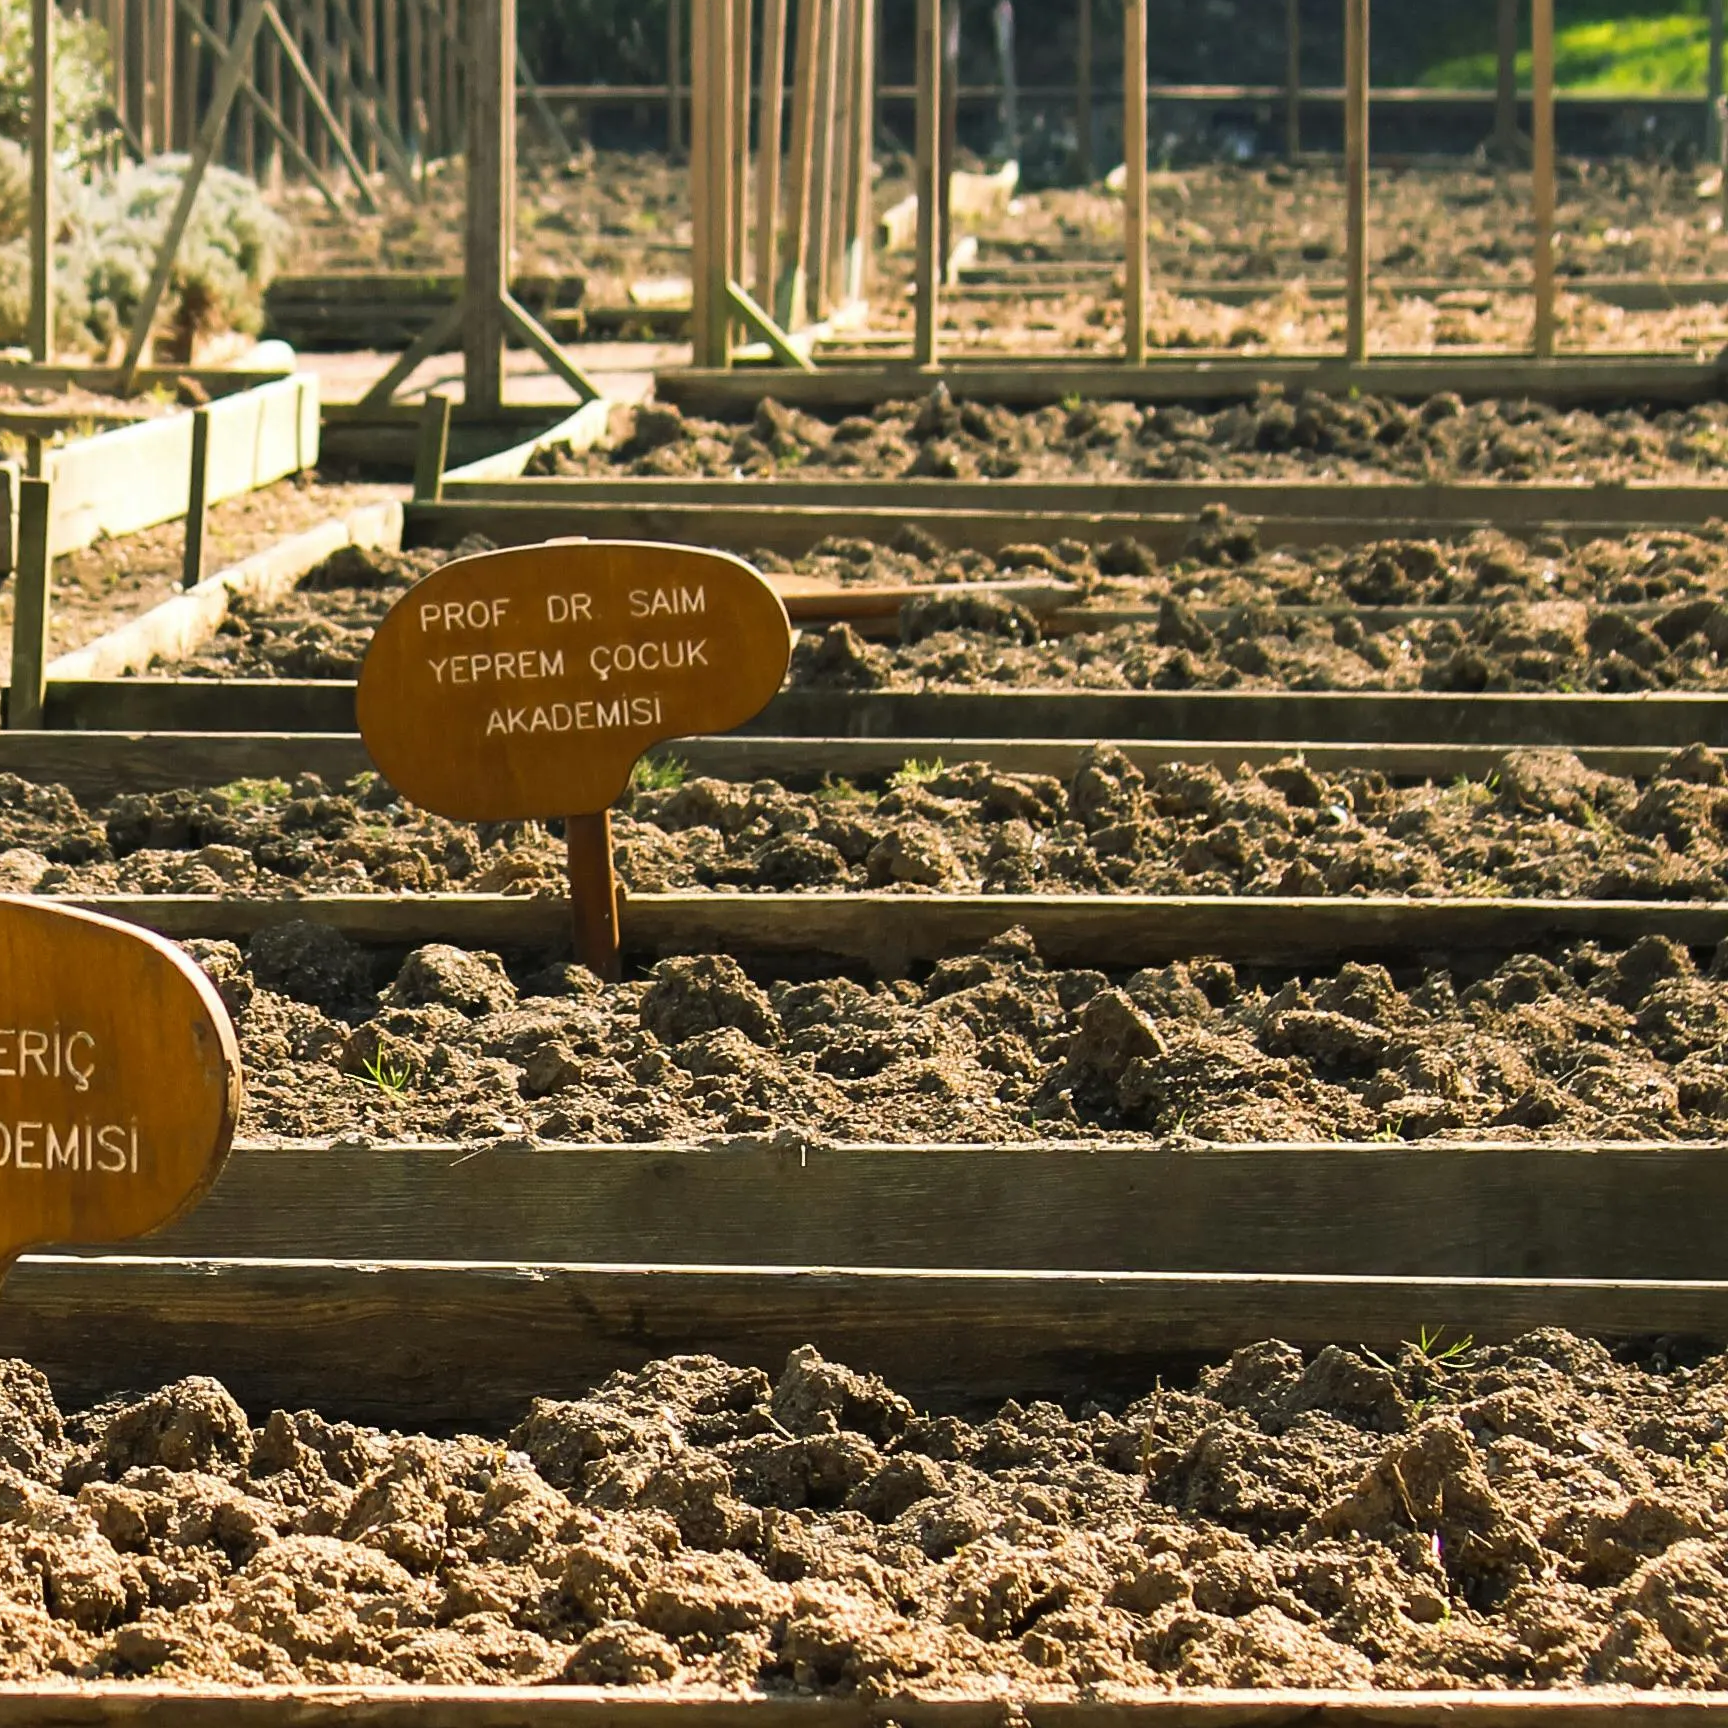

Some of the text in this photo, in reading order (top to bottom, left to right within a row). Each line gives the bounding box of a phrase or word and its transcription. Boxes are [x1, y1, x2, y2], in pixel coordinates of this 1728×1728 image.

[428, 638, 709, 684] YEPREM ÇOCUK
[485, 691, 662, 736] AKADEMİSİ
